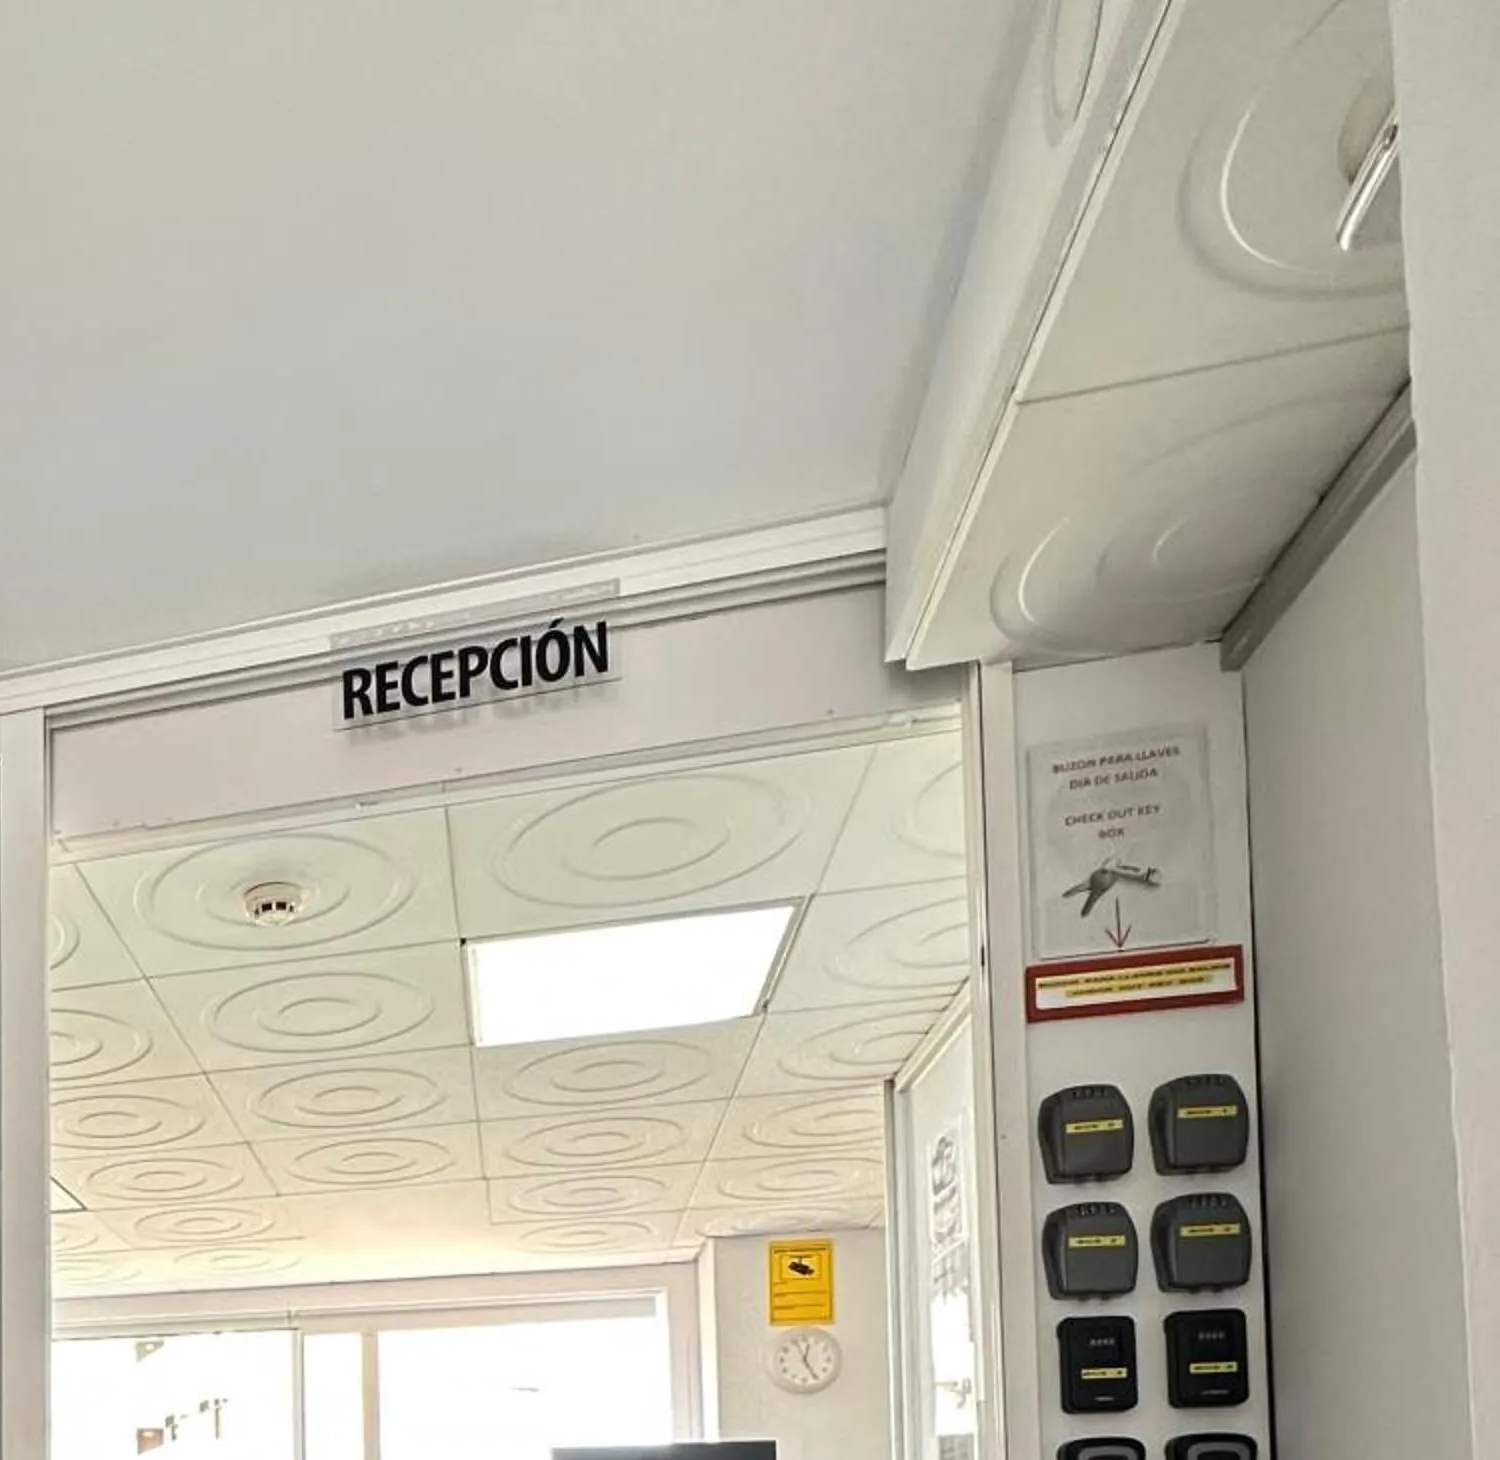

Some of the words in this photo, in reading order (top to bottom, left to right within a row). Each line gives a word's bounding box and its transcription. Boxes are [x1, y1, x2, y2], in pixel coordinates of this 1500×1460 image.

[342, 617, 609, 719] RECEPCIÓN
[1069, 776, 1091, 790] DIA
[1094, 775, 1110, 787] DE
[1115, 767, 1159, 783] SALIDA
[1064, 812, 1104, 827] CHECK
[1107, 807, 1135, 820] OUT
[1137, 803, 1160, 816] KEY
[1098, 827, 1125, 840] BOX
